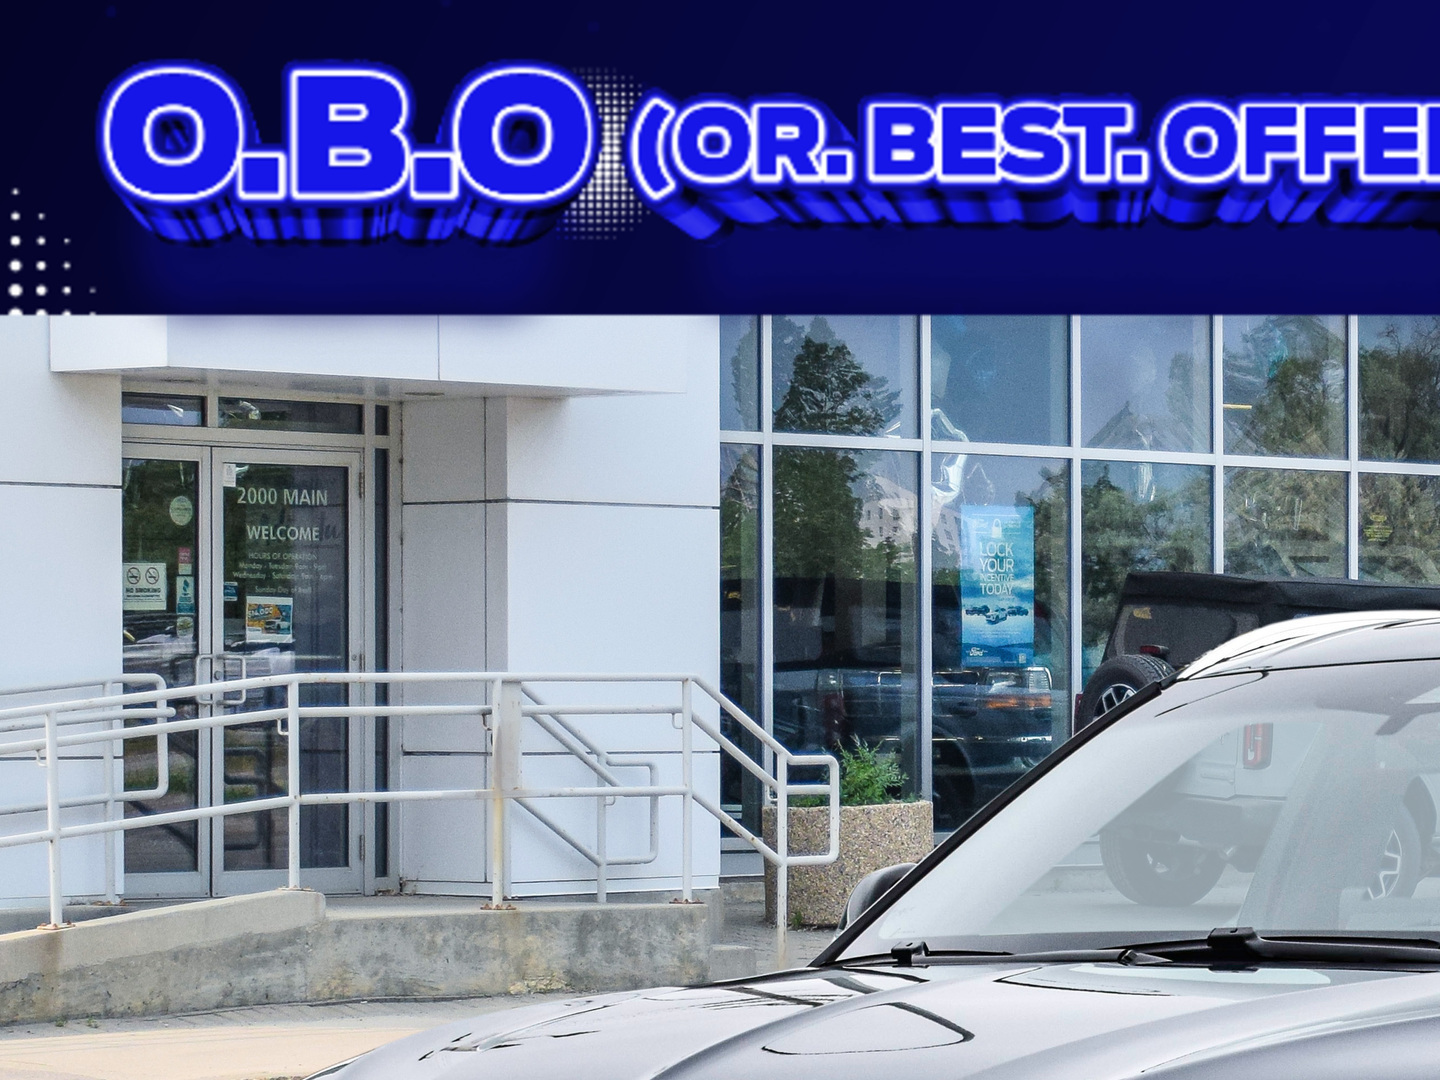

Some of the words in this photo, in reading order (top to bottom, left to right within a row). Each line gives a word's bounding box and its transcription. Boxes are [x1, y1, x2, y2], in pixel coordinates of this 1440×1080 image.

[237, 488, 277, 505] 2000
[283, 488, 328, 506] MAIN
[246, 525, 320, 541] WELCOME
[979, 541, 1014, 557] LOCK
[979, 558, 1015, 573] YOUR
[980, 583, 1013, 595] TODAY
